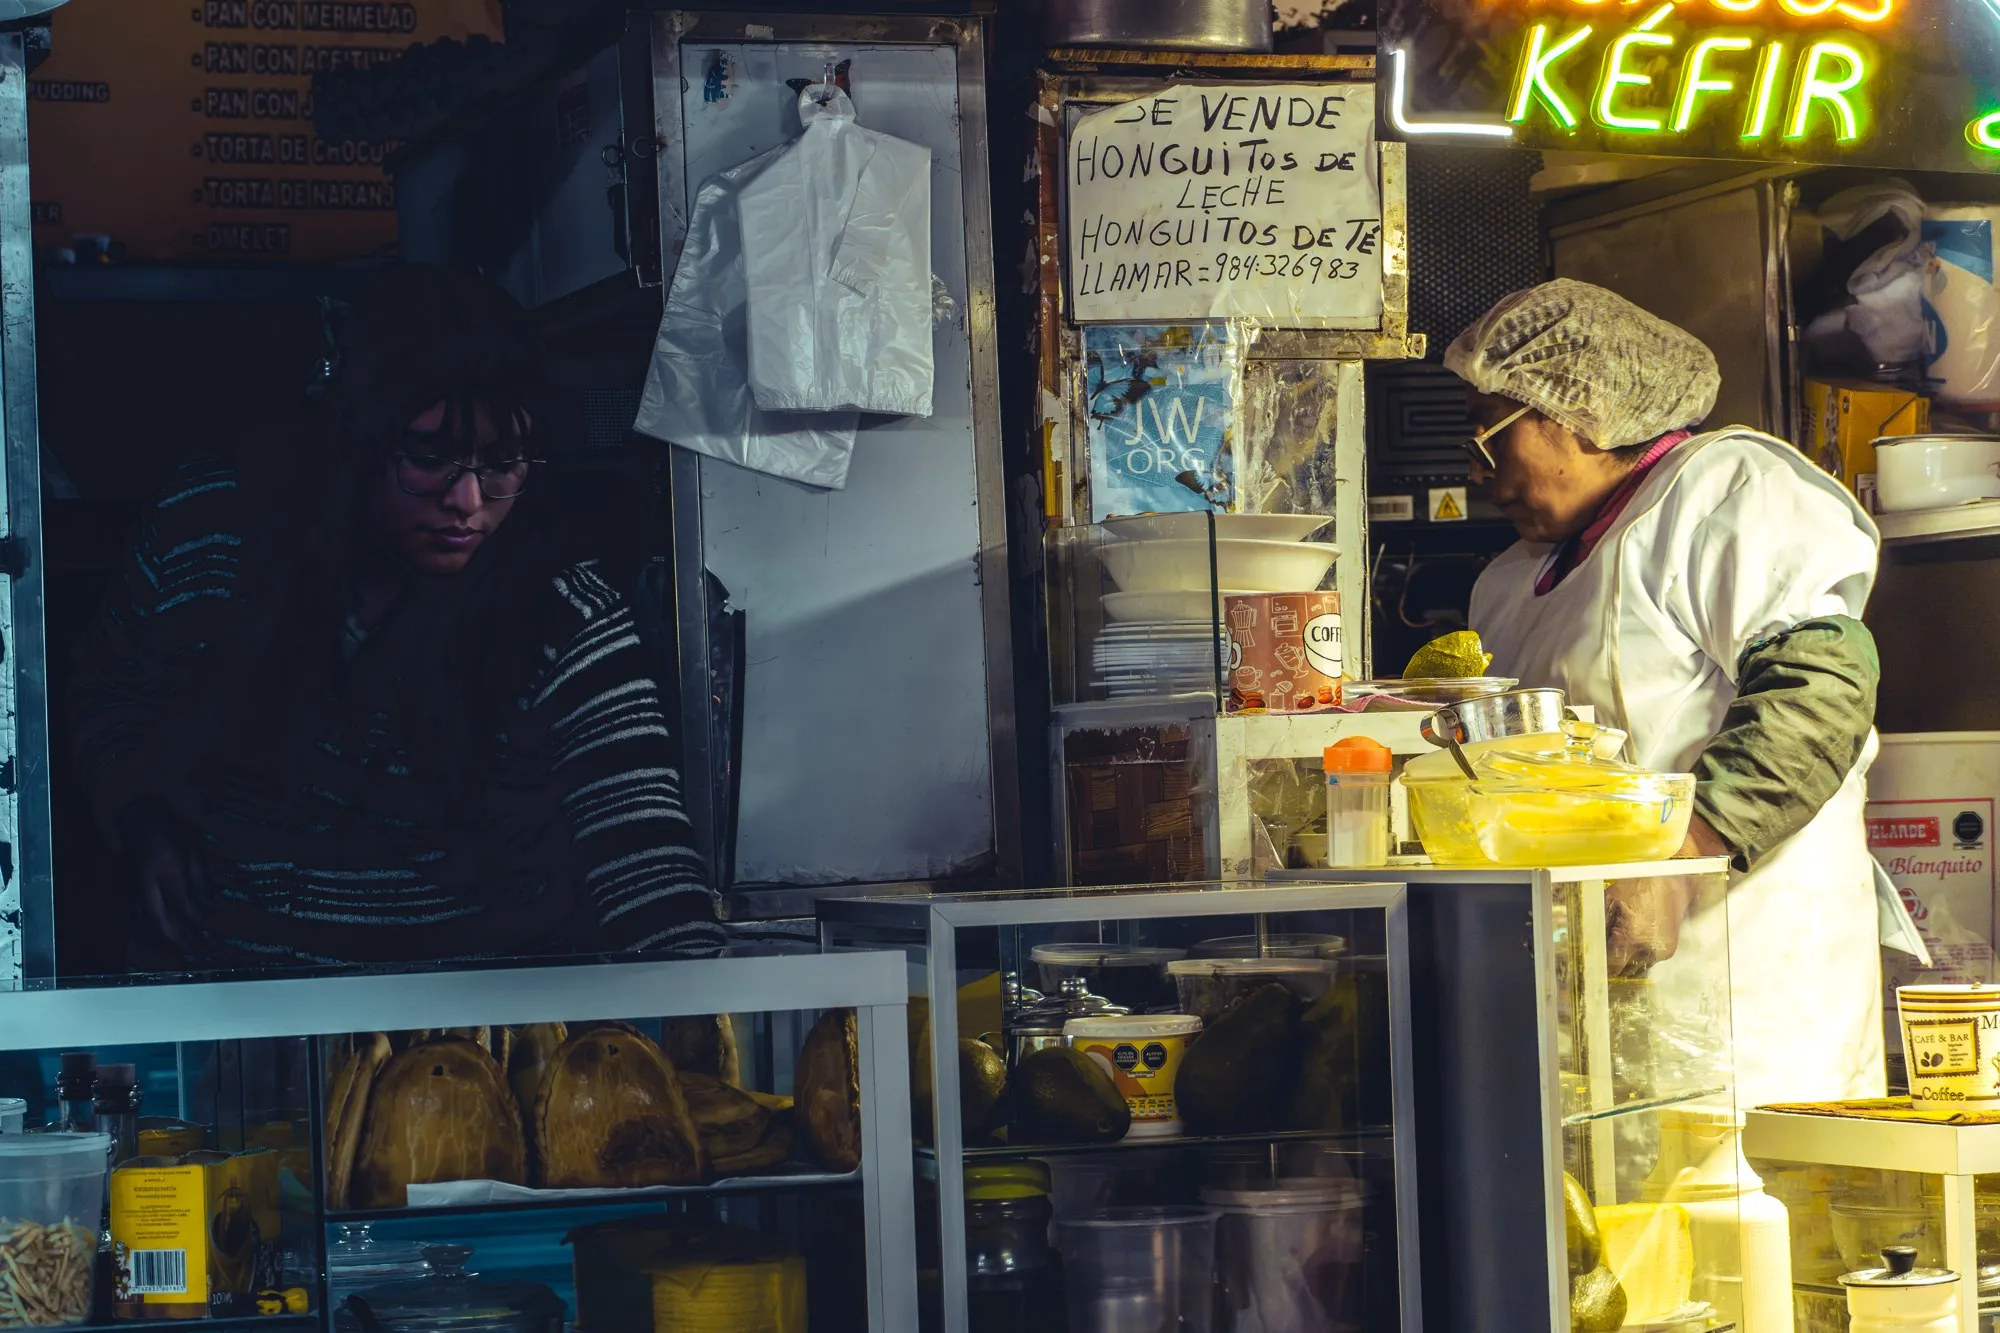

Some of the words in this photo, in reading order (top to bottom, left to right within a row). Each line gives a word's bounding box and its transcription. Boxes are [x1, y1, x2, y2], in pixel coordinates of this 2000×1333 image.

[205, 1, 246, 26] PAN
[253, 3, 296, 27] CON
[206, 46, 246, 72] PAN
[254, 48, 297, 73] CON
[1506, 3, 1863, 140] KÉFIR
[206, 90, 246, 116] PAN
[254, 92, 297, 117] CON
[1201, 92, 1345, 132] VENDE
[206, 136, 272, 161] TORTA
[281, 138, 306, 162] DE
[1315, 152, 1356, 172] DE
[206, 181, 274, 205] TORTA
[281, 183, 306, 206] DE
[313, 183, 394, 207] NARANJ
[1176, 175, 1285, 209] LECHE
[1292, 225, 1336, 250] DE
[1345, 218, 1380, 255] TÉ
[1124, 397, 1205, 445] JW
[1890, 855, 1983, 880] Blanquito
[1981, 1014, 2000, 1030] M
[1914, 1034, 1936, 1044] CAFÉ
[1938, 1034, 1946, 1043] &
[1949, 1033, 1970, 1042] BAR
[1921, 1086, 1965, 1101] Coffee
